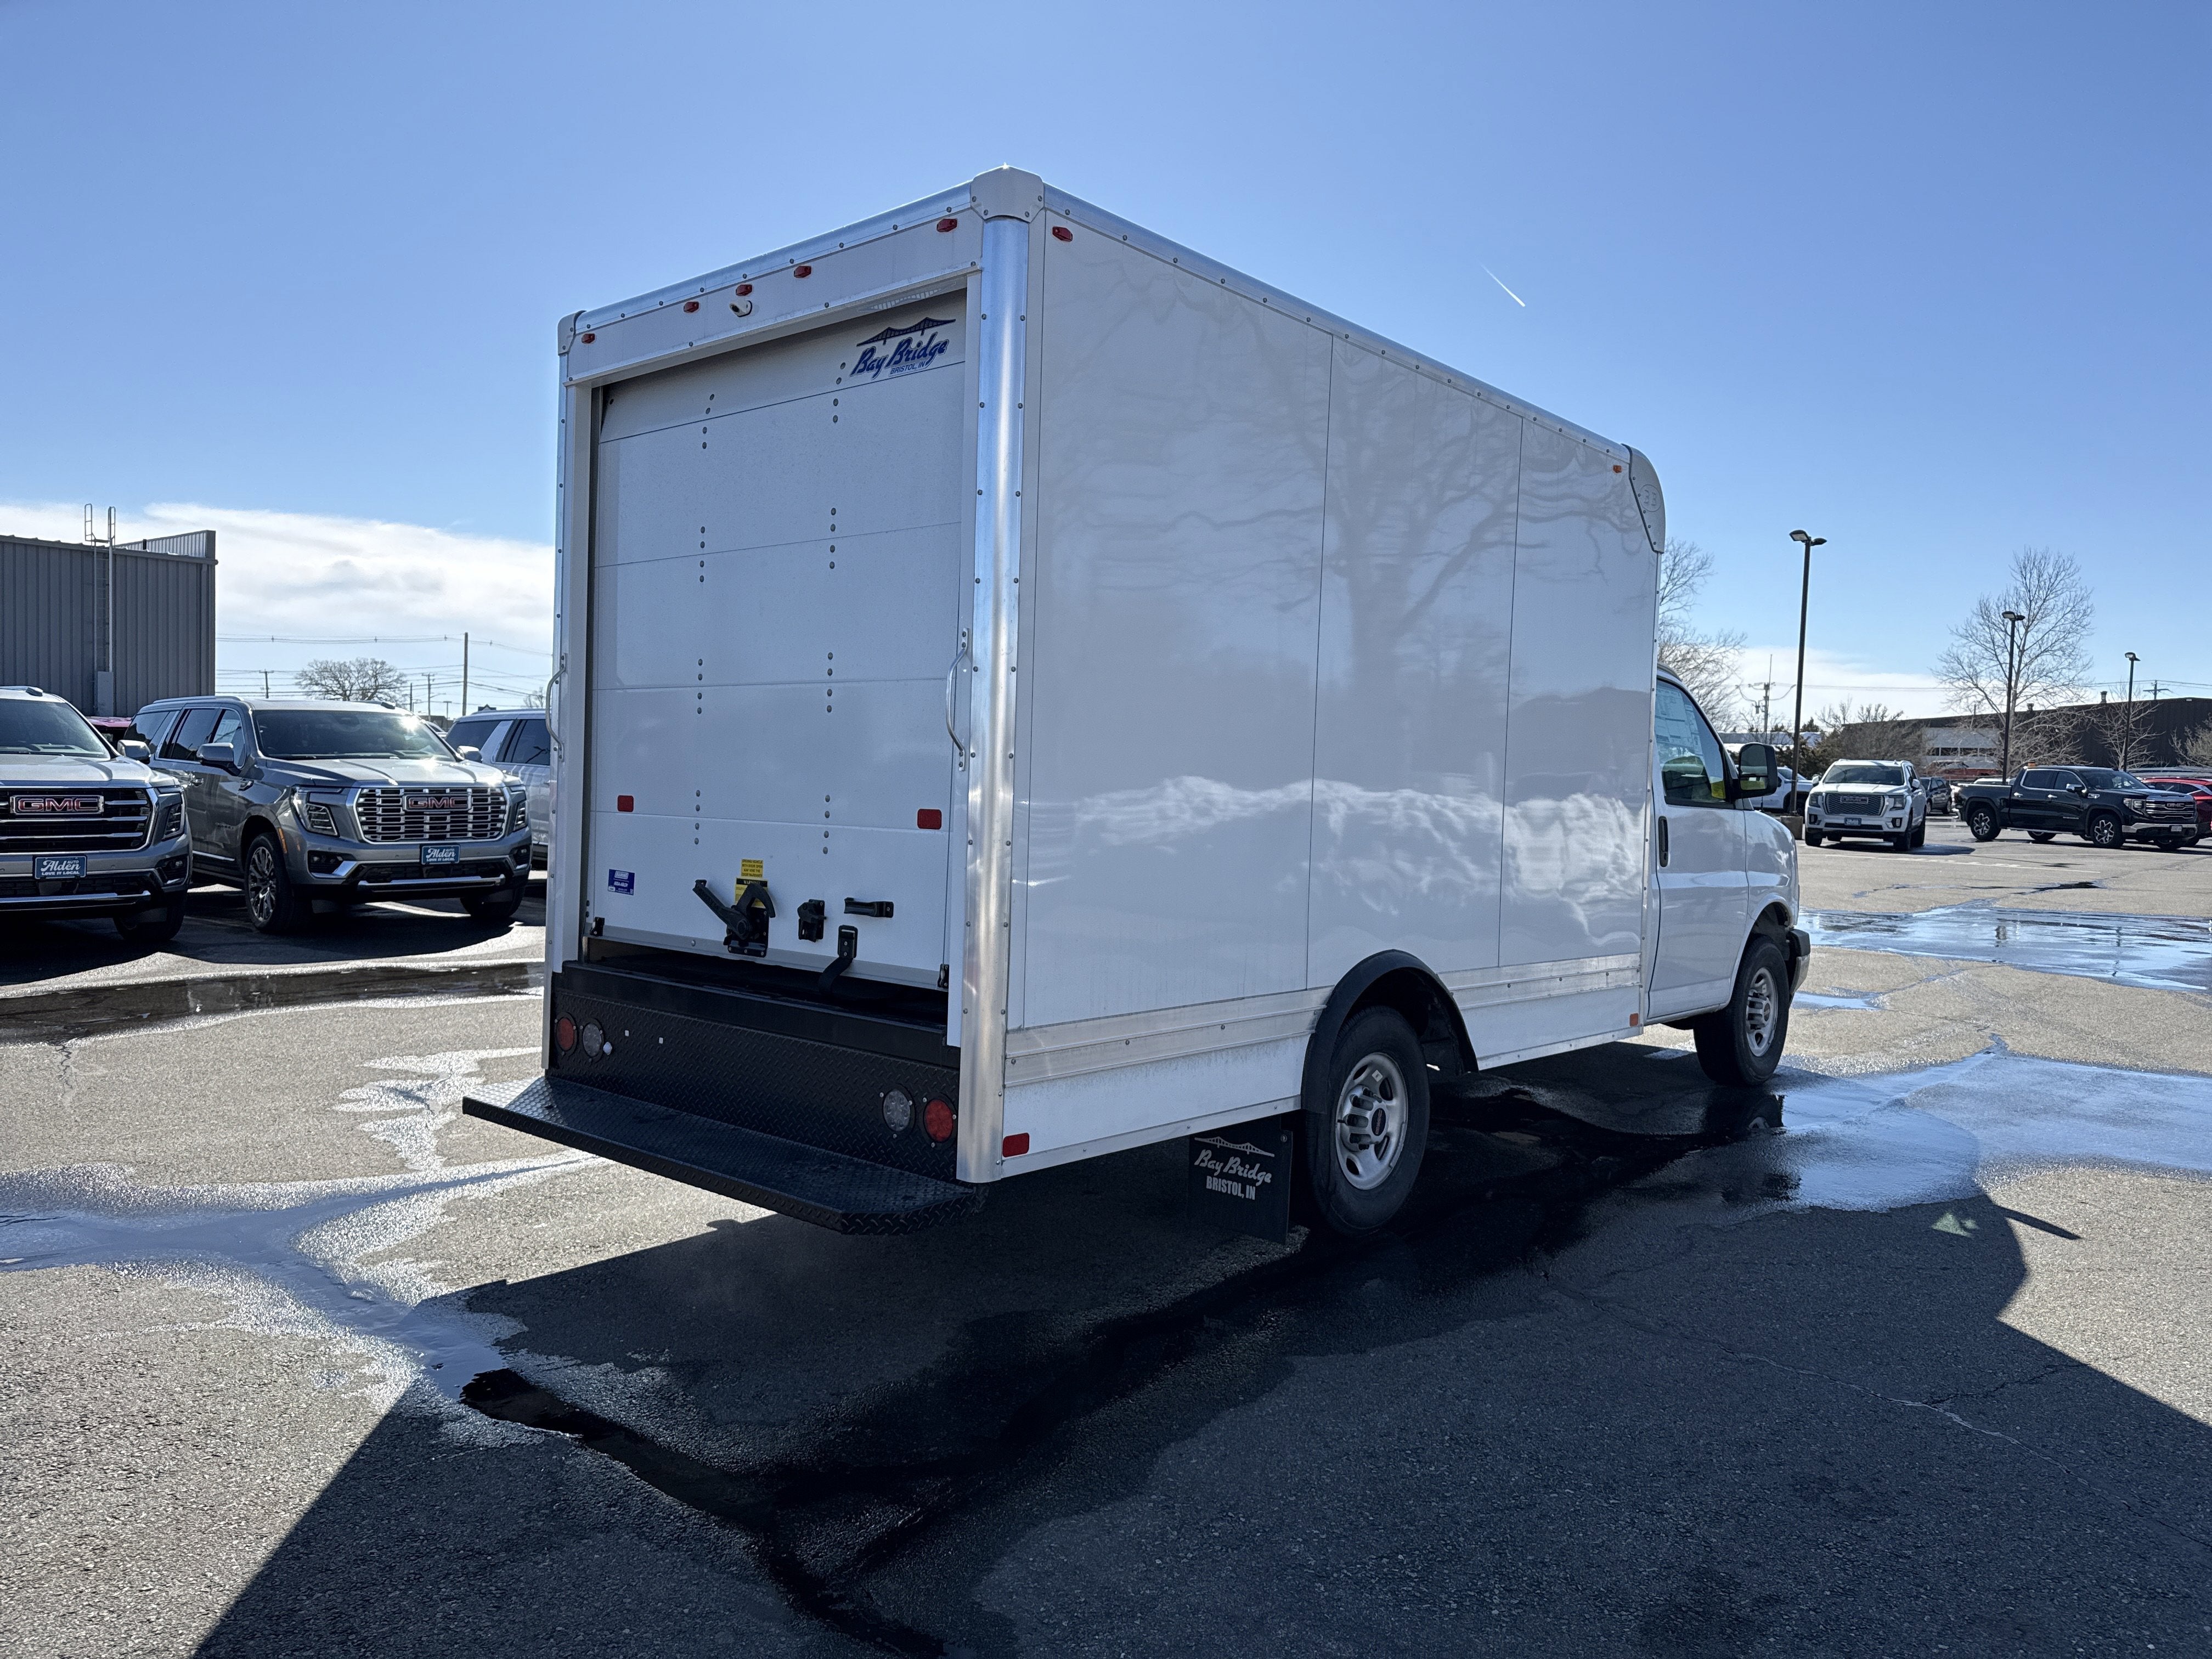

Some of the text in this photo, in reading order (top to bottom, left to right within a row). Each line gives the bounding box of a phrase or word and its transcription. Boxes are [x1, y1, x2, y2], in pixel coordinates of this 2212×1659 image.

[850, 331, 949, 379] Bay Bridge
[890, 364, 917, 375] BRISTOL,
[18, 798, 98, 812] GMC
[409, 797, 468, 808] GMC
[426, 848, 456, 859] Alden
[41, 860, 81, 871] Alden
[1194, 1149, 1272, 1187] Bay Bridge
[1206, 1175, 1256, 1200] BRISTOL, IN
